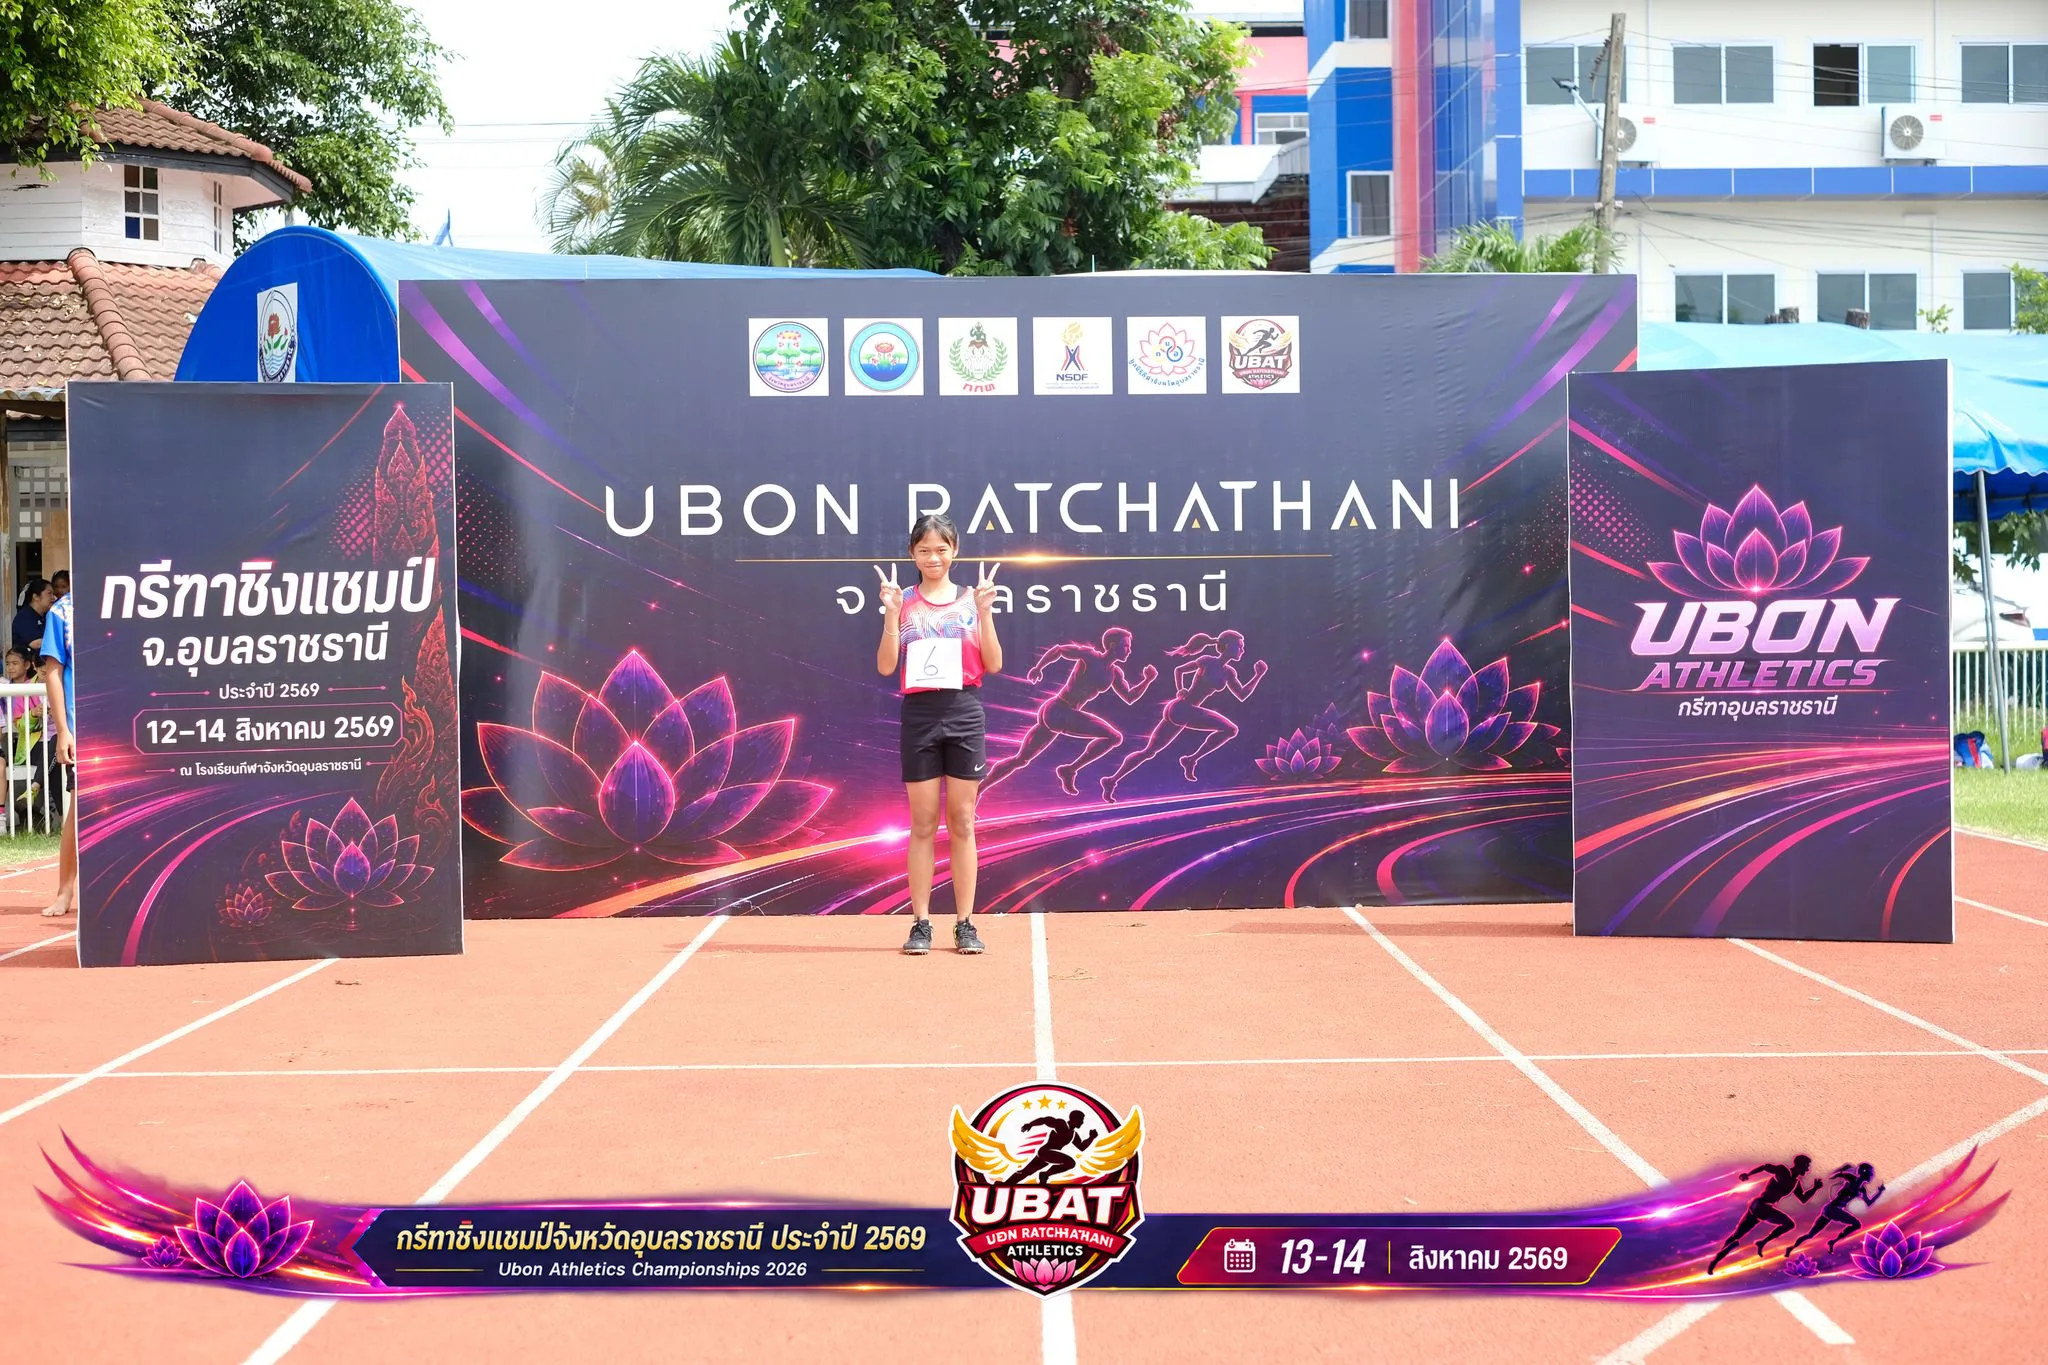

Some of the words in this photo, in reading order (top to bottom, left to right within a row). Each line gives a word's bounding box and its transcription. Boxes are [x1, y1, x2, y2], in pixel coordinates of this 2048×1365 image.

[1234, 355, 1288, 369] UBAT
[1056, 373, 1088, 381] NSDF
[605, 483, 859, 537] UBON
[908, 479, 1460, 535] RATCHATHANI
[100, 556, 436, 619] กรีฑาชิงแชมป์
[1630, 598, 1901, 656] UBON
[142, 620, 389, 678] จ.อุบลราชธานี
[923, 645, 939, 676] 6
[1633, 659, 1894, 692] ATHLETICS
[219, 681, 275, 700] ประจำปี
[279, 682, 320, 698] 2569
[1677, 694, 1839, 722] กรีฑาอุบลราชธานี
[235, 716, 325, 742] สิงหาคม
[334, 715, 394, 739] 2569
[179, 766, 192, 776] ณ
[195, 757, 362, 776] โรงเรียนกีฬาจังหวัดอุบลราชธานี
